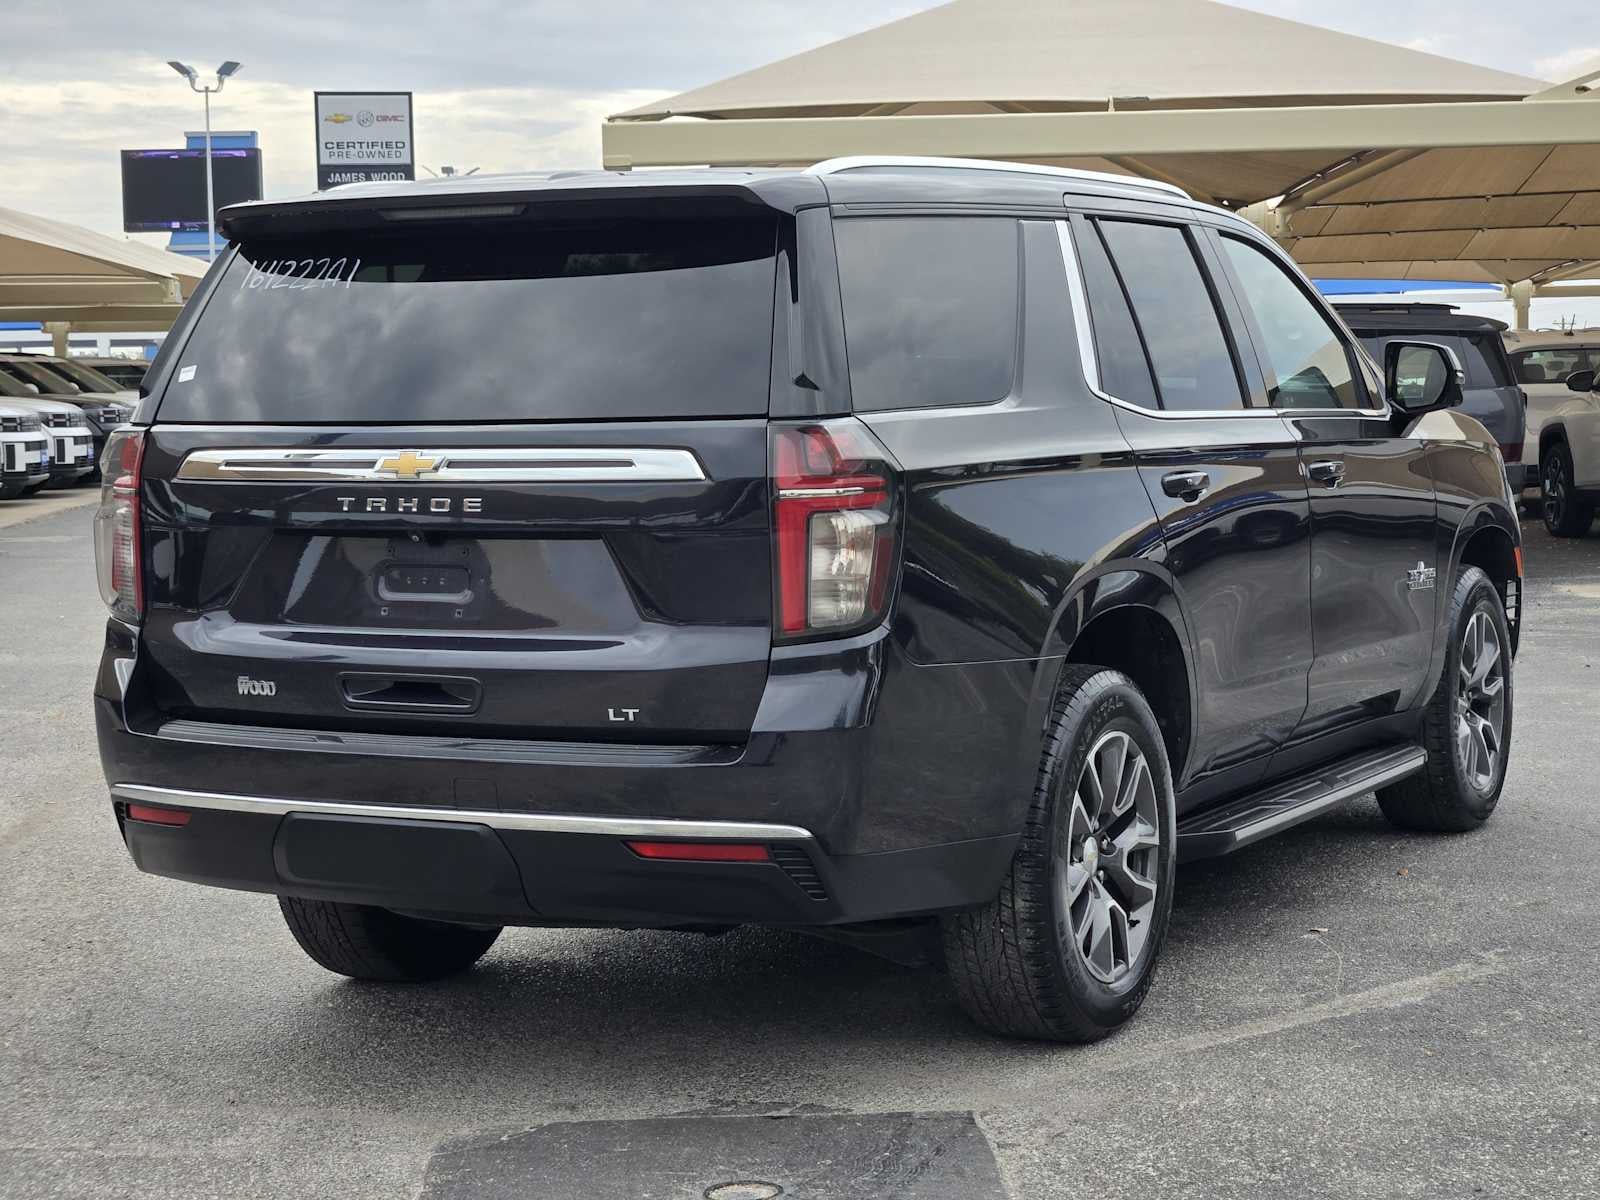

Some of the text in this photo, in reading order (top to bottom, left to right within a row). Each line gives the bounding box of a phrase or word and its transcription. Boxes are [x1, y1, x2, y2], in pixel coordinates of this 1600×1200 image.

[324, 141, 406, 150] CERTIFIED
[328, 150, 402, 159] PRE-OWNED
[327, 172, 405, 183] JAMES WOOD
[337, 497, 482, 511] TAHOE
[237, 679, 276, 696] WOOD
[607, 708, 640, 721] LT
